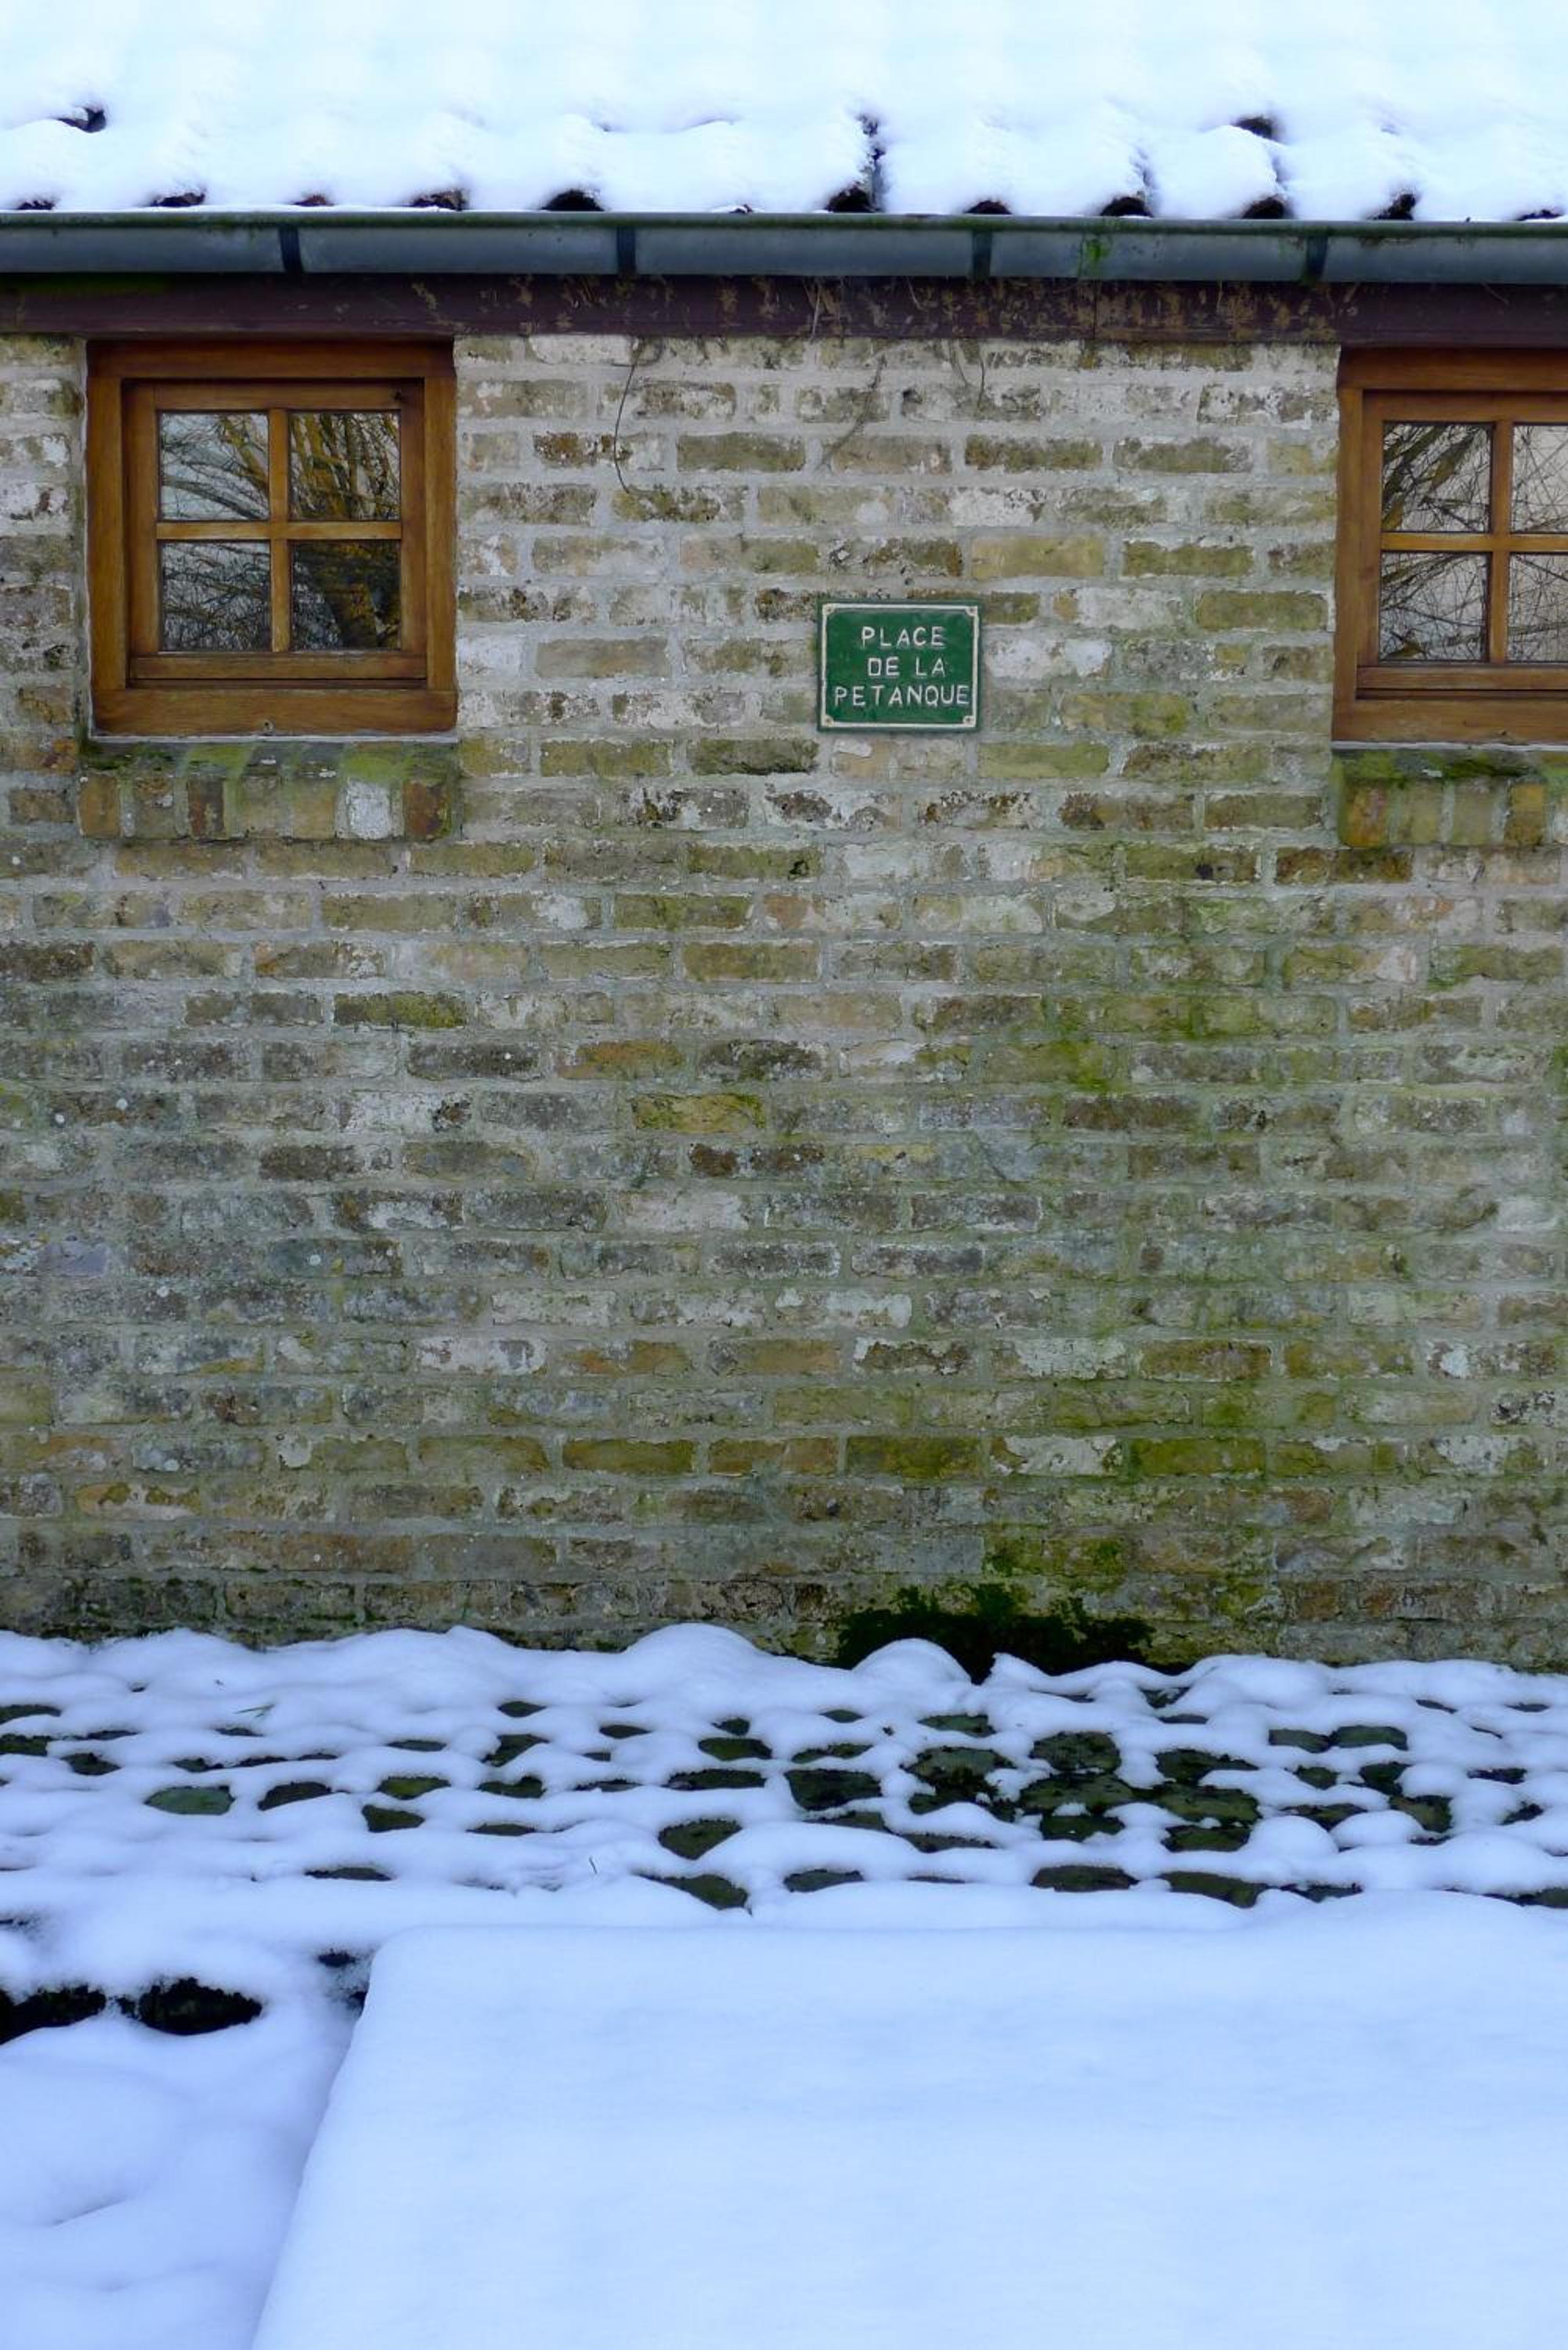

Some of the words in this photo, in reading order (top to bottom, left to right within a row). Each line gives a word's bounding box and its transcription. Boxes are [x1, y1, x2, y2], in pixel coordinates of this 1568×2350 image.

[862, 626, 945, 647] PLACE
[867, 656, 900, 677] DE
[915, 657, 946, 677] LA
[835, 685, 970, 707] PETANQUE
